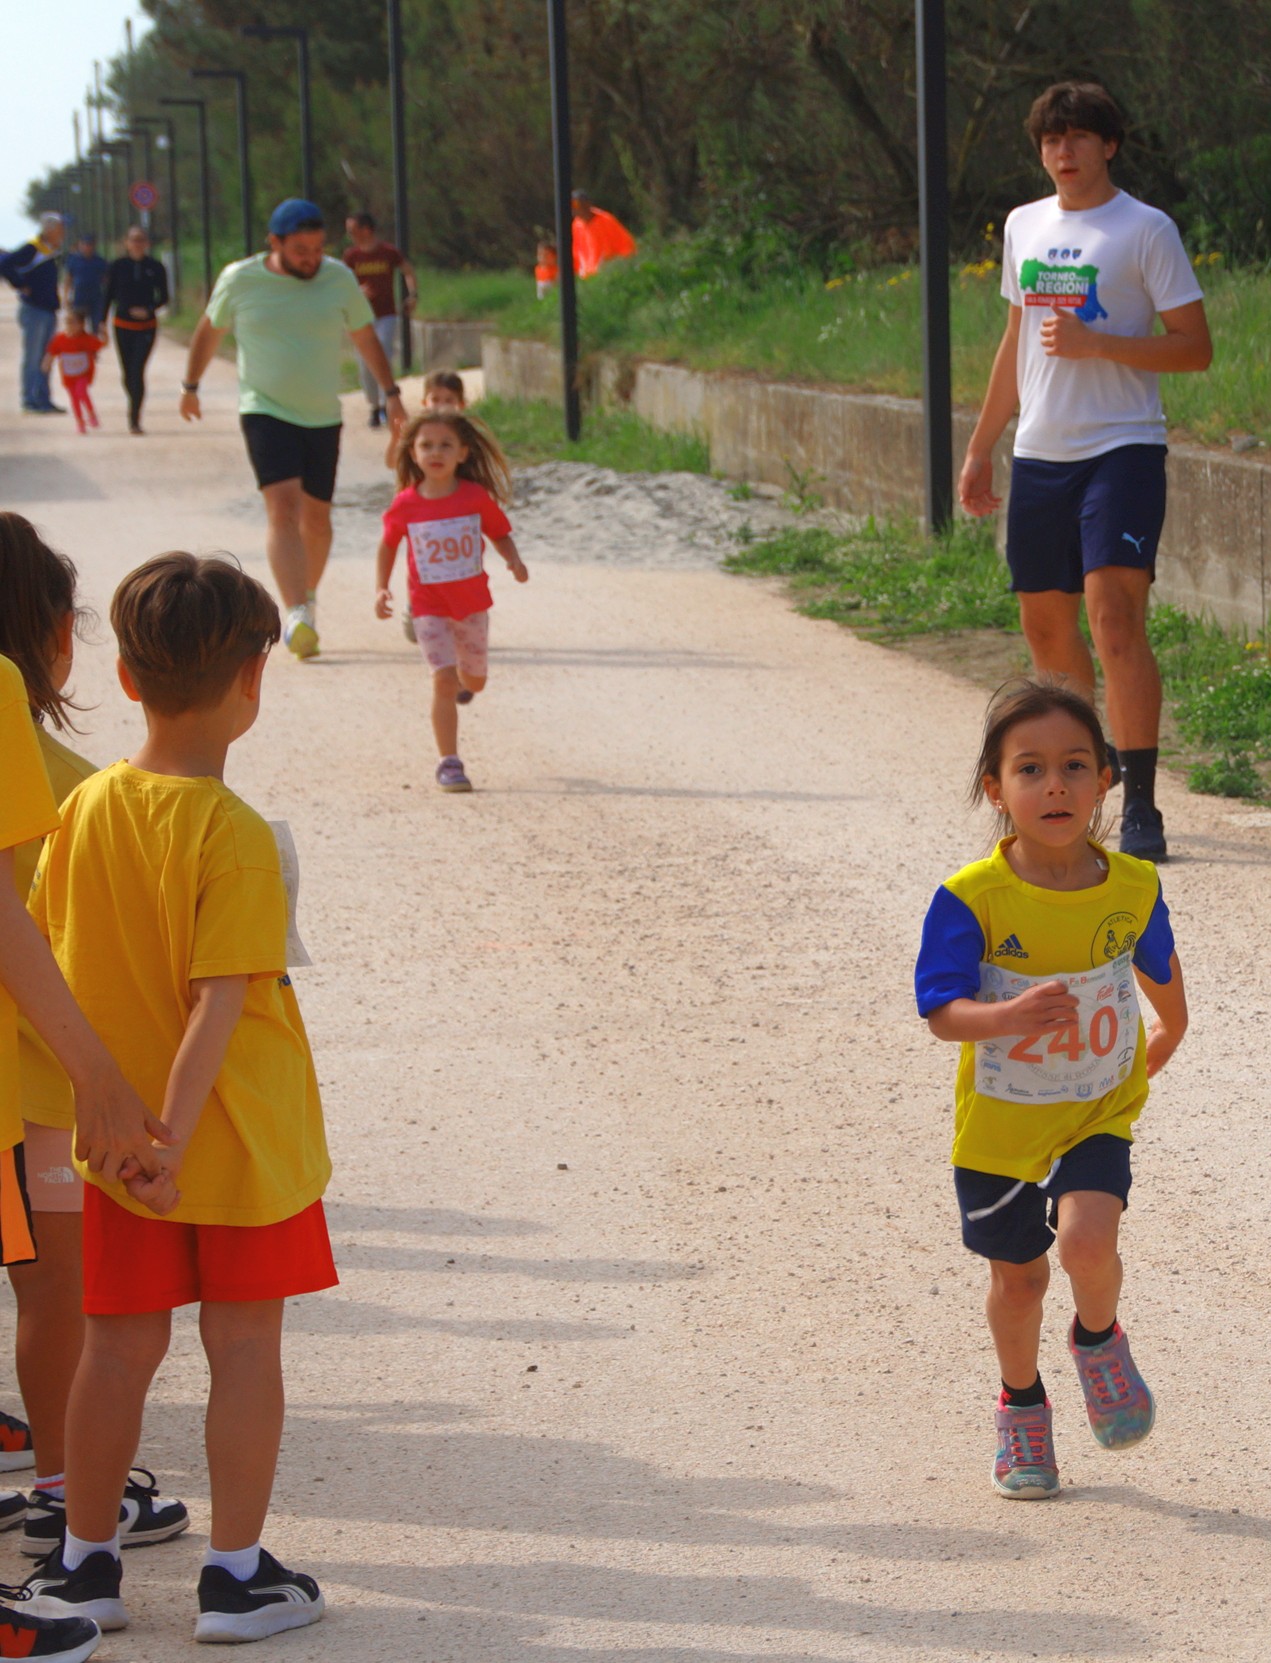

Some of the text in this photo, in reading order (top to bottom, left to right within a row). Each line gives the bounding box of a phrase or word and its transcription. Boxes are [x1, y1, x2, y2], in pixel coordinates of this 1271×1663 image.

[1038, 271, 1076, 281] TORNEO
[1036, 281, 1089, 295] REGIONI
[426, 534, 474, 564] 290
[1107, 915, 1134, 927] ATLETICA
[994, 948, 1029, 959] adidas
[1007, 1005, 1119, 1064] 240
